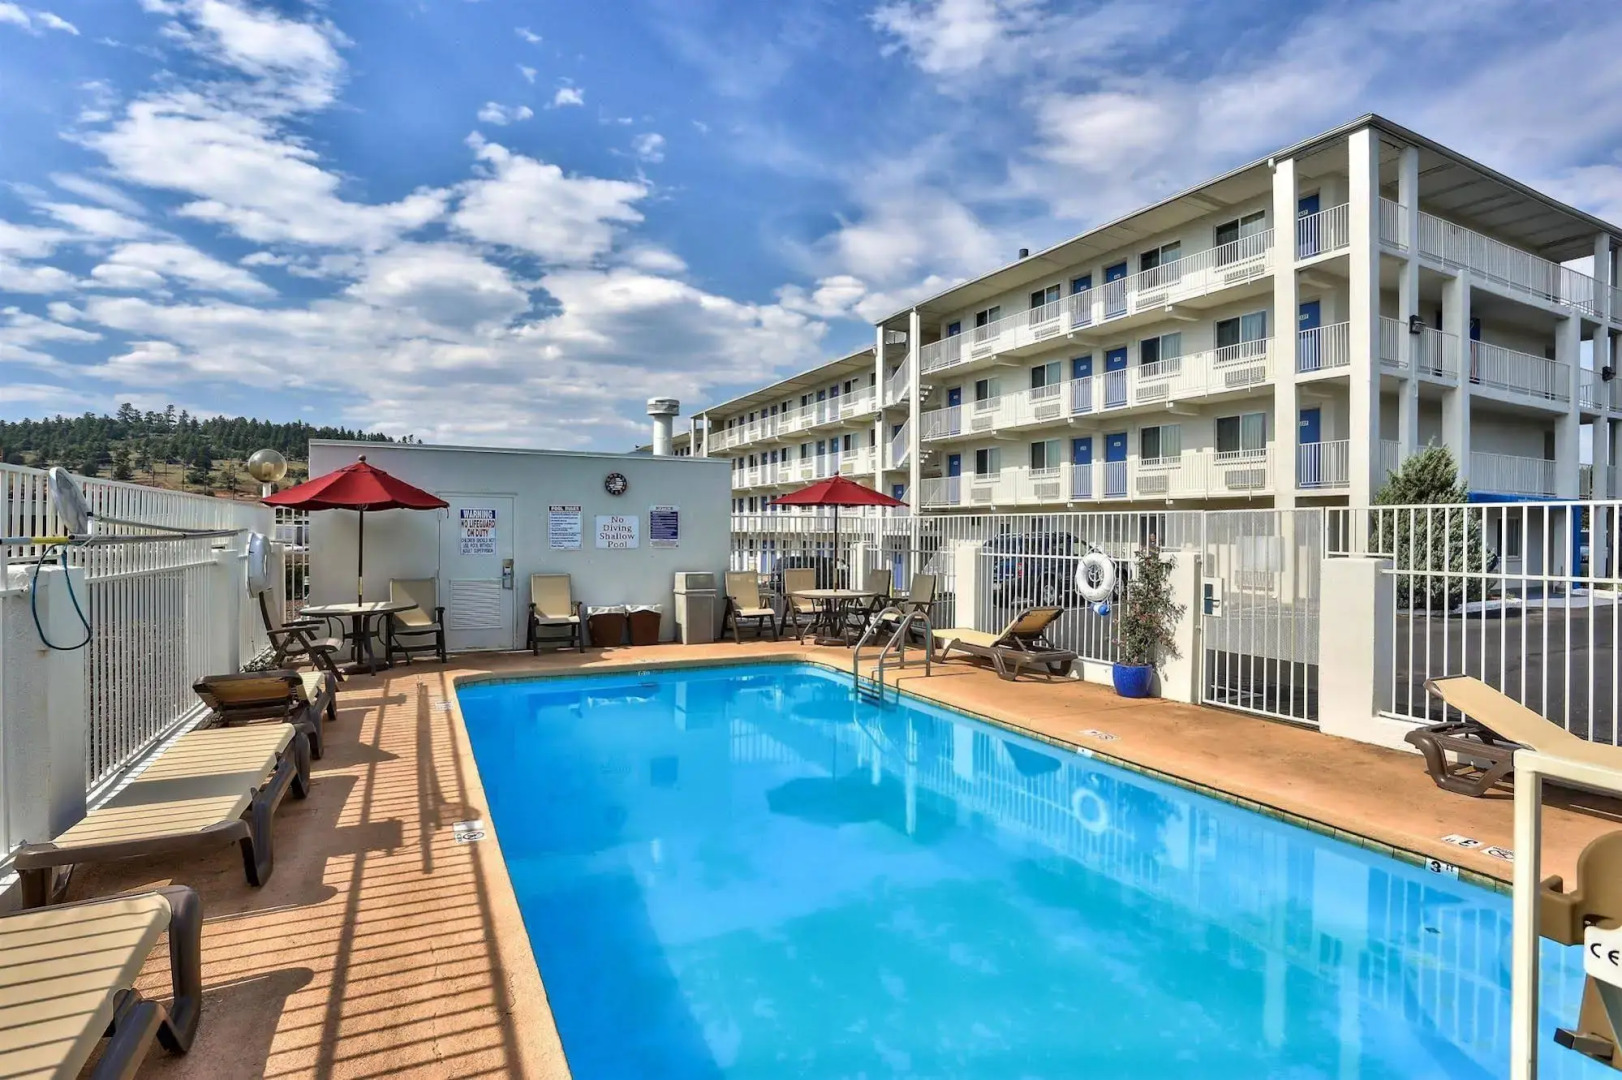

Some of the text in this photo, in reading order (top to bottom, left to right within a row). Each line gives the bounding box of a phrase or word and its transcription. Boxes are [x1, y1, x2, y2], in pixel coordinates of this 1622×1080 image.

[463, 510, 493, 519] WARNING
[461, 520, 495, 528] NO LIFEGUARD
[603, 524, 632, 533] Diving
[467, 529, 489, 537] ON DUTY
[599, 532, 635, 540] Shallow
[607, 540, 628, 548] Pool
[1430, 861, 1441, 873] 3
